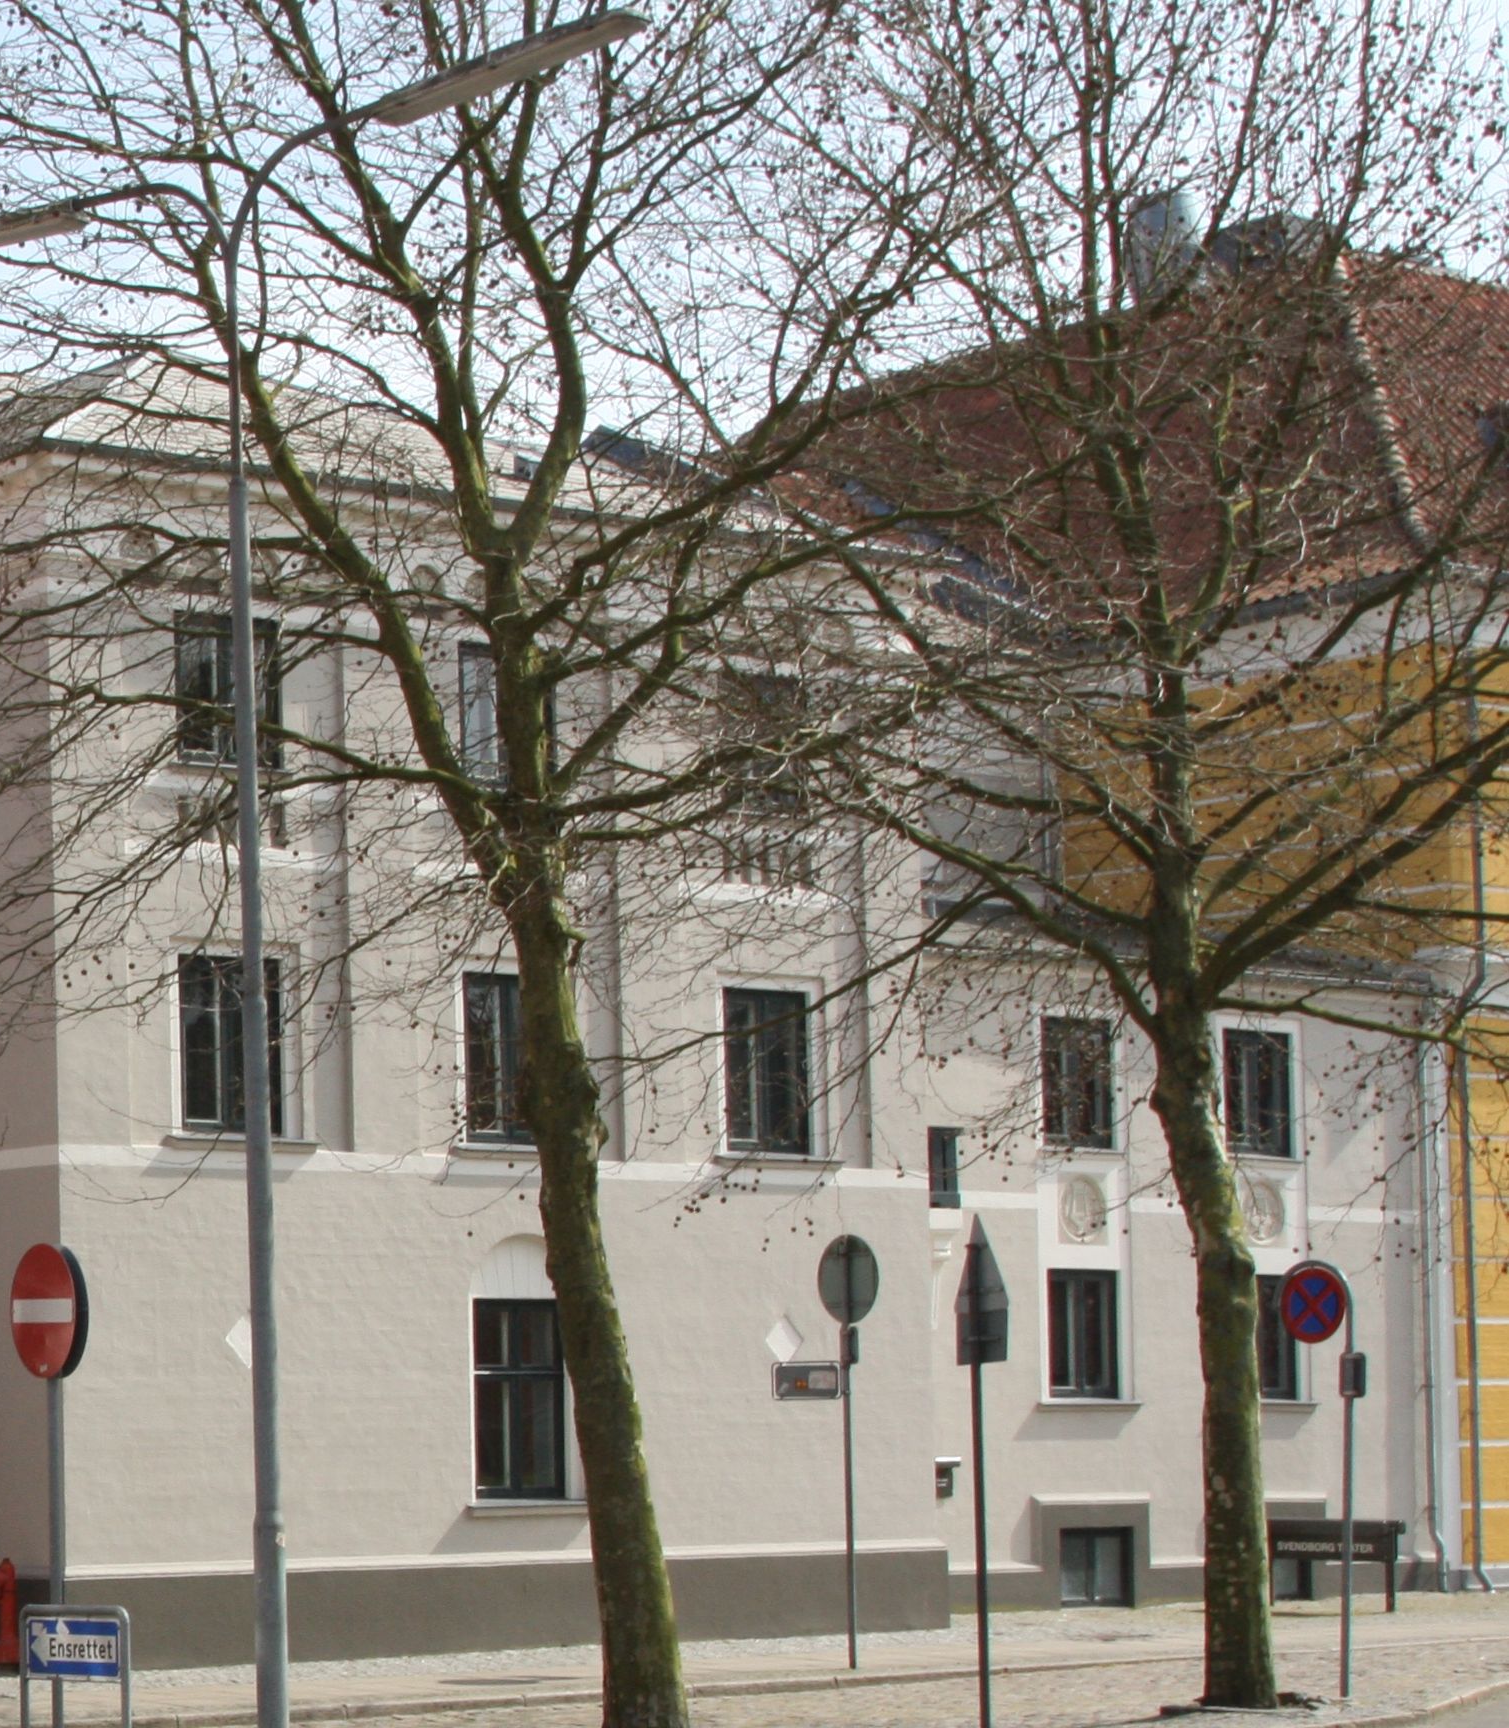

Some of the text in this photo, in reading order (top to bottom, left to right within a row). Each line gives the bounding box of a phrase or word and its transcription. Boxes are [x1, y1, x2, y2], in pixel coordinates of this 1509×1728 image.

[1277, 1541, 1373, 1553] SVENDBORG TATER
[49, 1638, 113, 1660] Ensrettet
